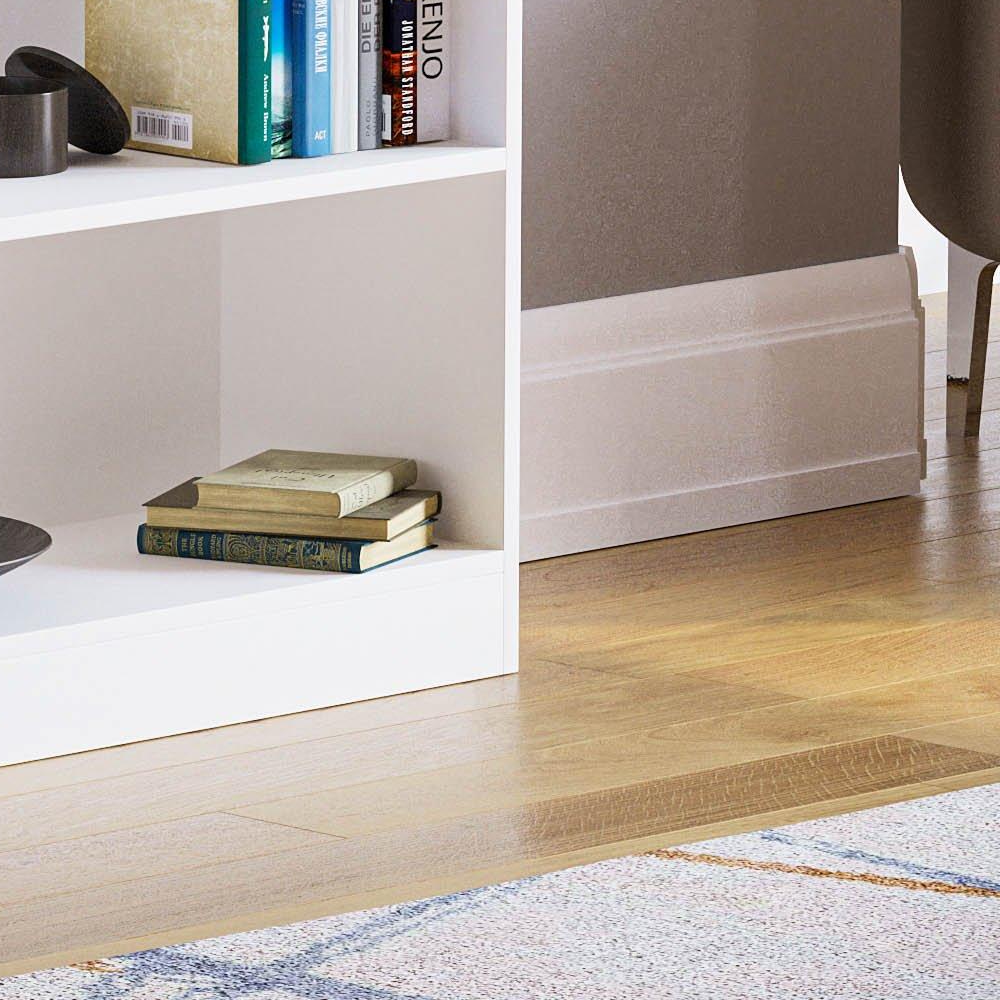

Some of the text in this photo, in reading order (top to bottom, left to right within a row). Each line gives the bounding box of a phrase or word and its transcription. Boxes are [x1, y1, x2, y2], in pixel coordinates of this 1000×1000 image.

[362, 22, 371, 53] DIE
[401, 20, 414, 136] JONATHAN STANDFORD
